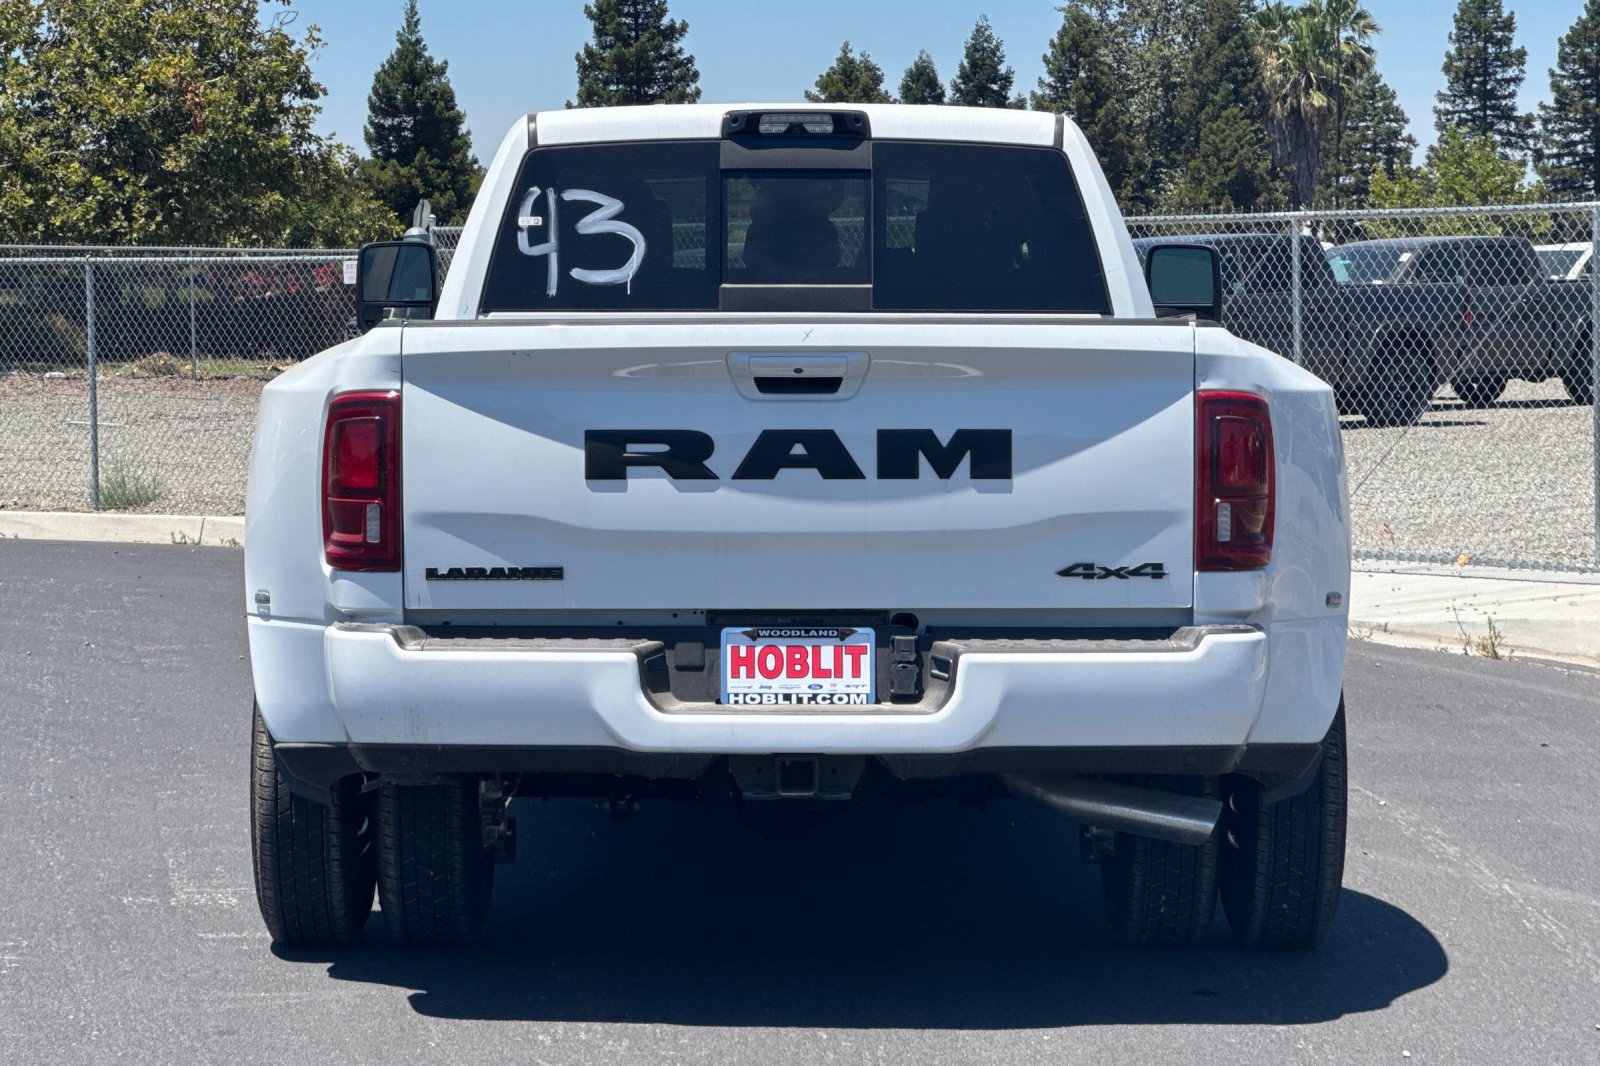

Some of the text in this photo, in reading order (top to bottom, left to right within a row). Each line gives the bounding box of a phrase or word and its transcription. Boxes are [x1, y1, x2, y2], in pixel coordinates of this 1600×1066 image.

[518, 186, 646, 298] 43
[584, 429, 1013, 480] RAM
[425, 566, 564, 581] LARAMIE
[1054, 562, 1169, 580] 4x4
[758, 629, 838, 637] WOODLAND
[730, 644, 868, 679] HOBLIT
[729, 693, 867, 704] HOBLIT.COM
